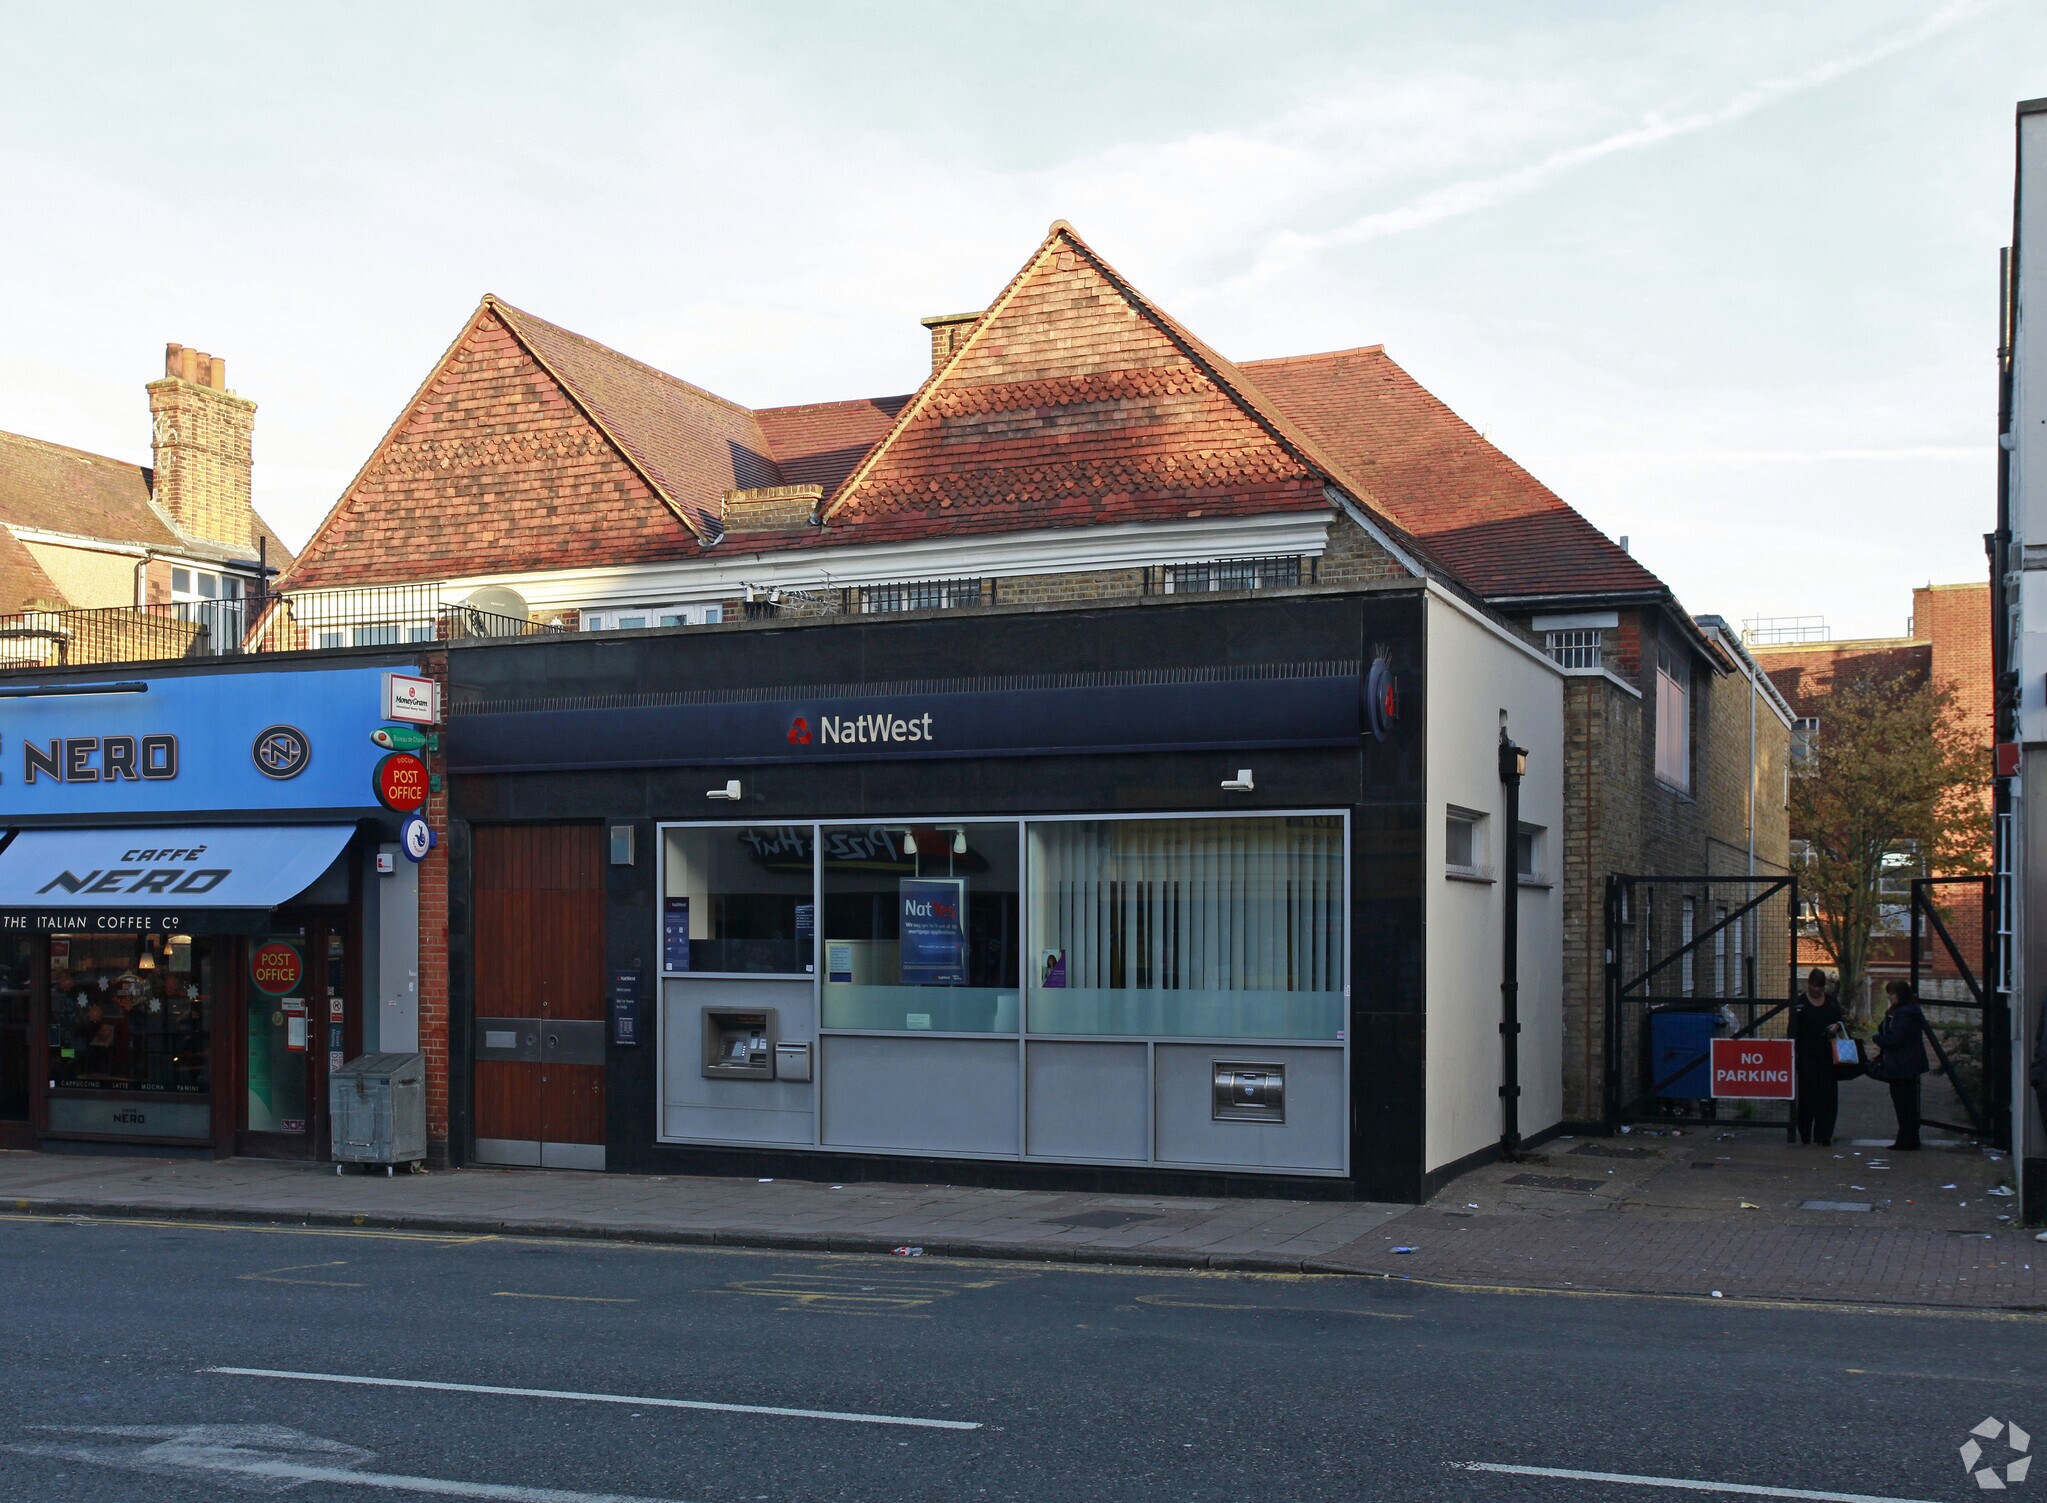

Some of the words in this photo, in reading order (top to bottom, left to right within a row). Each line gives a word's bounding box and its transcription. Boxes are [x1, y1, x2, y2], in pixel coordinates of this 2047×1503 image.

[395, 695, 428, 707] MoneyGram
[821, 712, 933, 744] NatWest
[24, 733, 178, 784] NERO
[393, 770, 418, 784] POST
[388, 786, 422, 800] OFFICE
[34, 868, 232, 894] NERO
[905, 899, 955, 919] NatYes
[4, 916, 27, 928] THE
[37, 916, 87, 928] ITALIAN
[97, 916, 151, 928] COFFEE
[261, 953, 291, 966] POST
[256, 968, 295, 981] OFFICE
[1741, 1052, 1763, 1064] NO
[1717, 1069, 1788, 1082] PARKING
[61, 1080, 100, 1088] CAPPUCCINO
[113, 1113, 145, 1124] NERO
